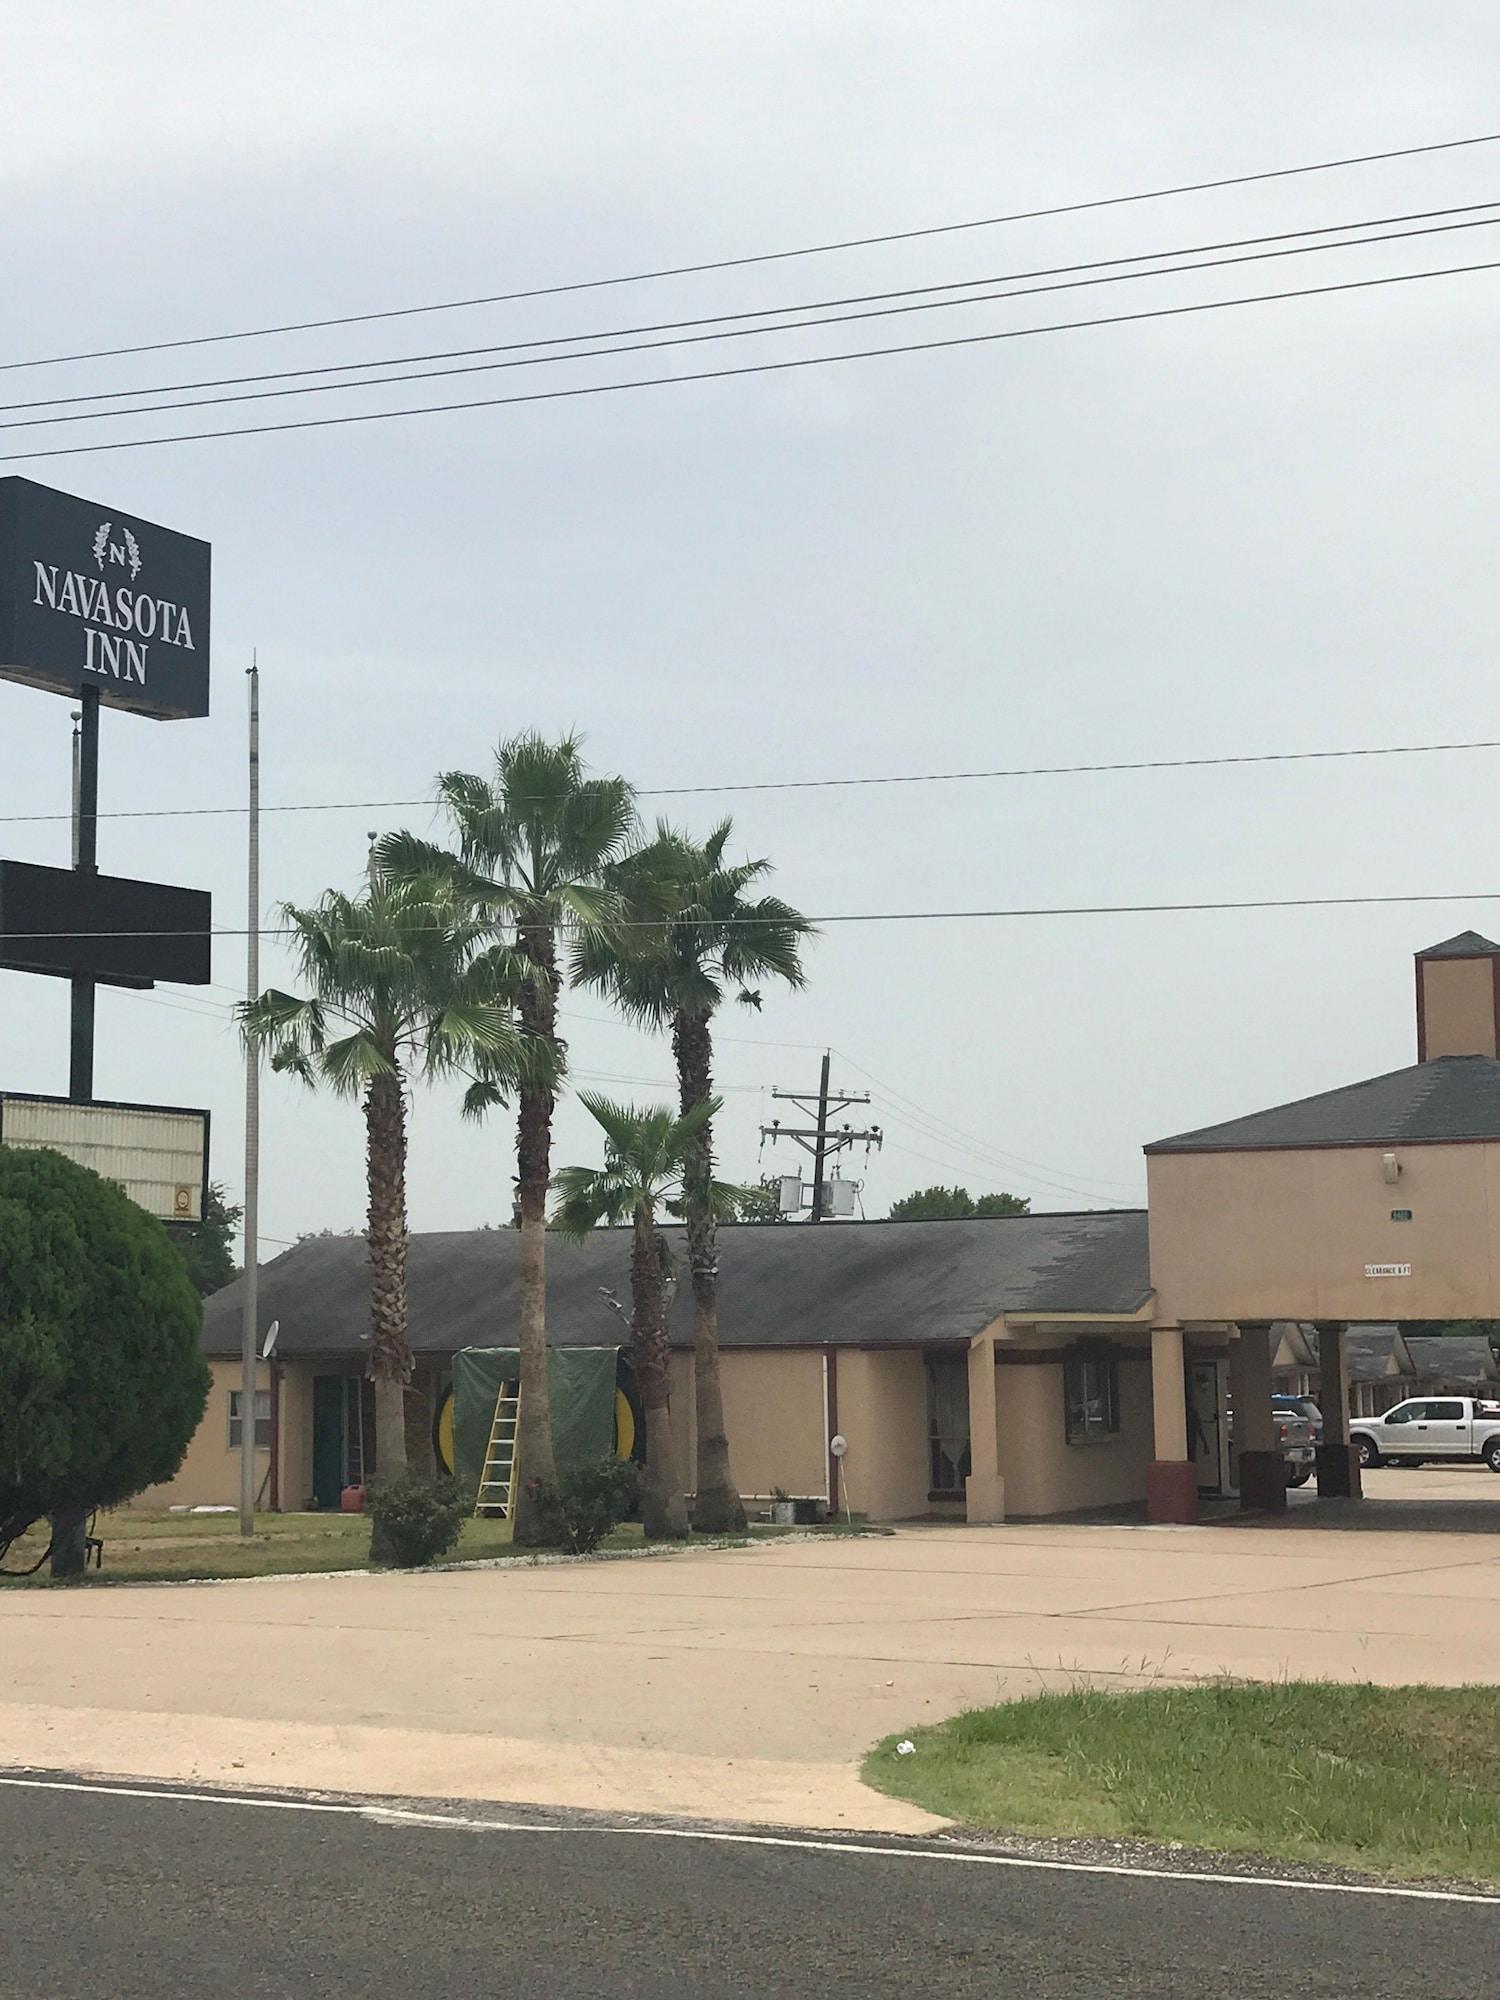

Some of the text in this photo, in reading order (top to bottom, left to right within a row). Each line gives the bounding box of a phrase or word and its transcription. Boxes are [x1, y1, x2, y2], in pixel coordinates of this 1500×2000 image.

[109, 542, 125, 567] N
[33, 560, 195, 650] NAVASOTA
[83, 627, 149, 685] INN
